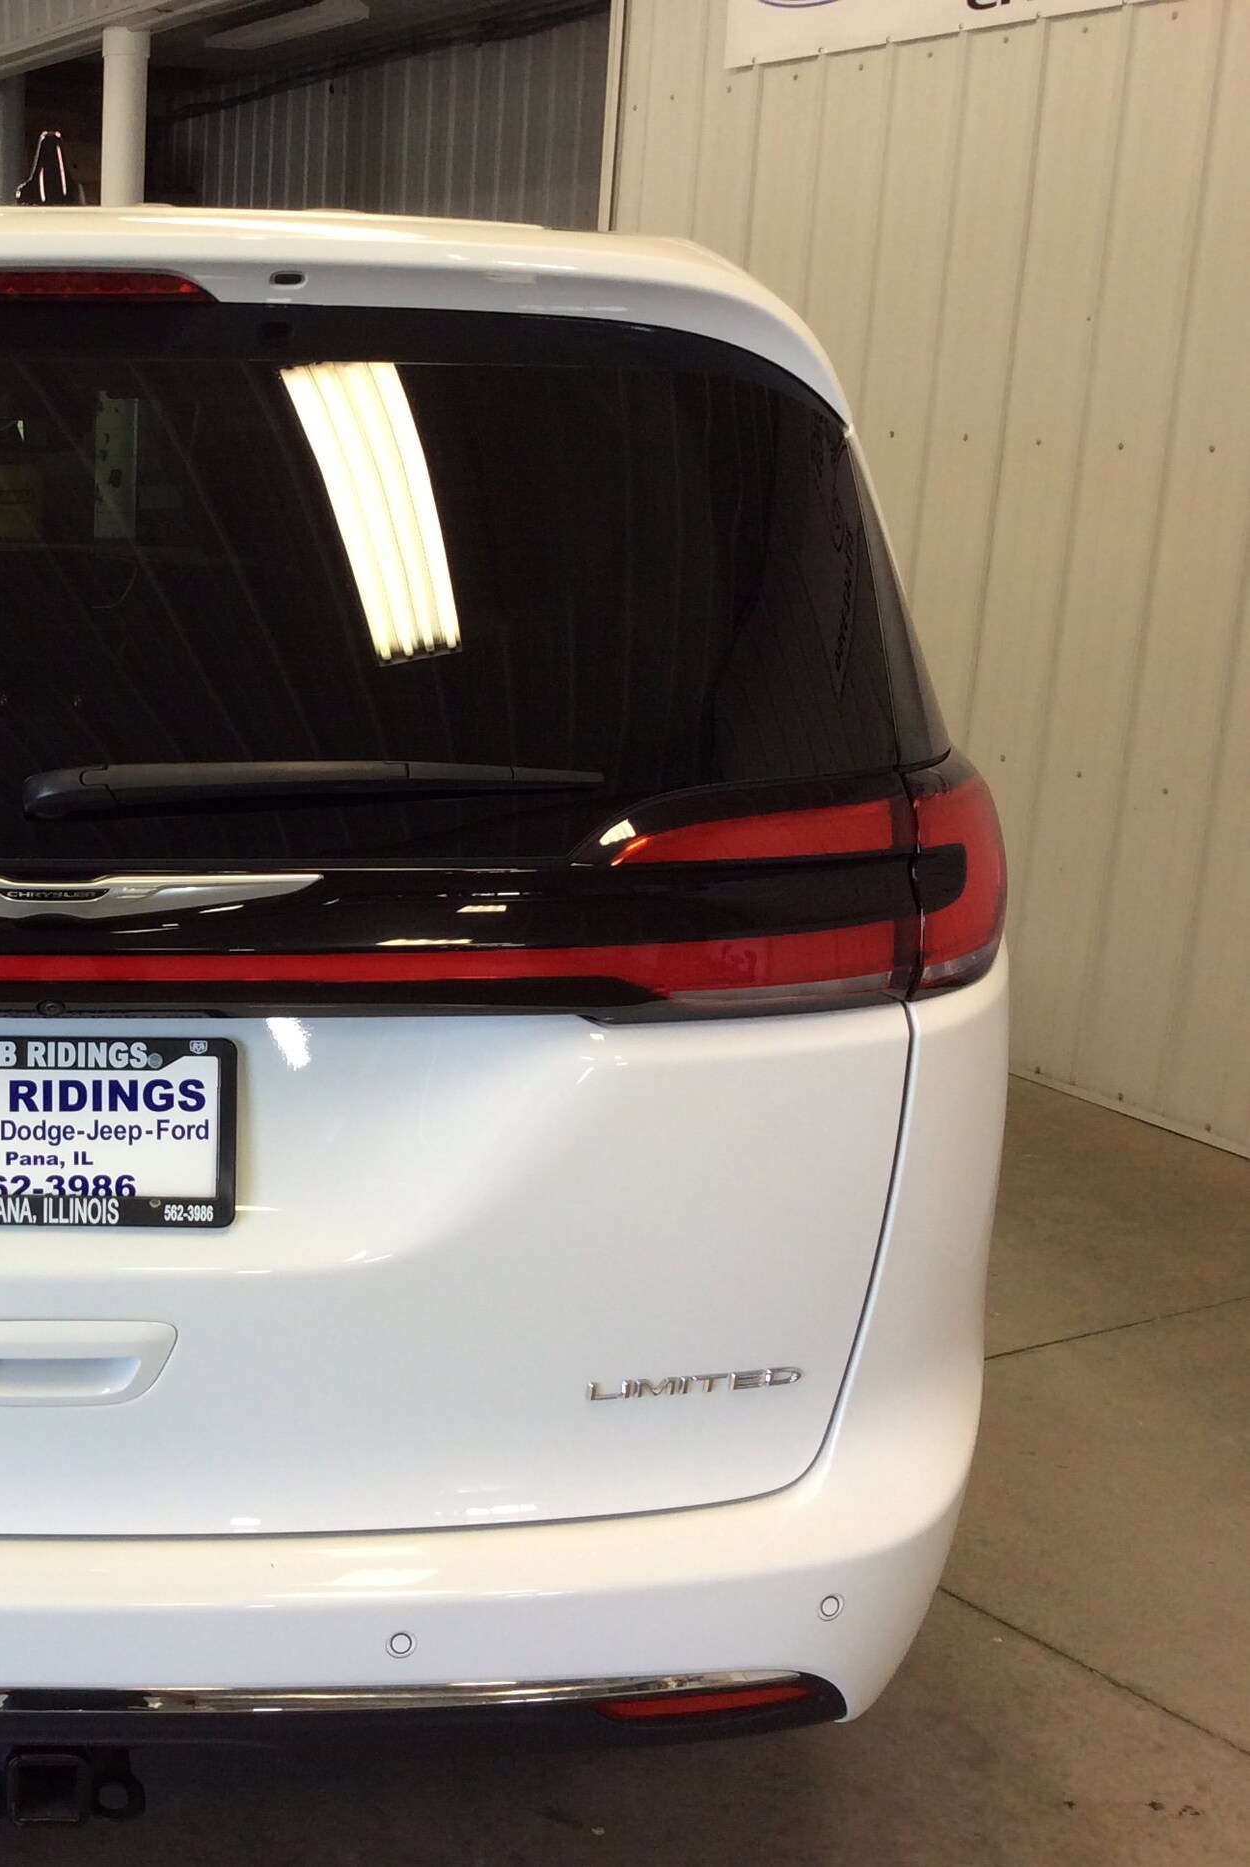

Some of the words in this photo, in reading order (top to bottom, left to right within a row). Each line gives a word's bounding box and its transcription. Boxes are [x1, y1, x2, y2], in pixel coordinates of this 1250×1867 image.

[6, 890, 97, 899] CHRYSLER
[27, 1041, 149, 1069] RIDINGS
[9, 1079, 207, 1113] RIDINGS
[5, 1151, 66, 1169] Pana,
[73, 1151, 94, 1166] IL
[43, 1197, 120, 1225] ILLINOIS
[163, 1204, 214, 1222] 562-3986
[587, 1366, 802, 1401] LIMITED
